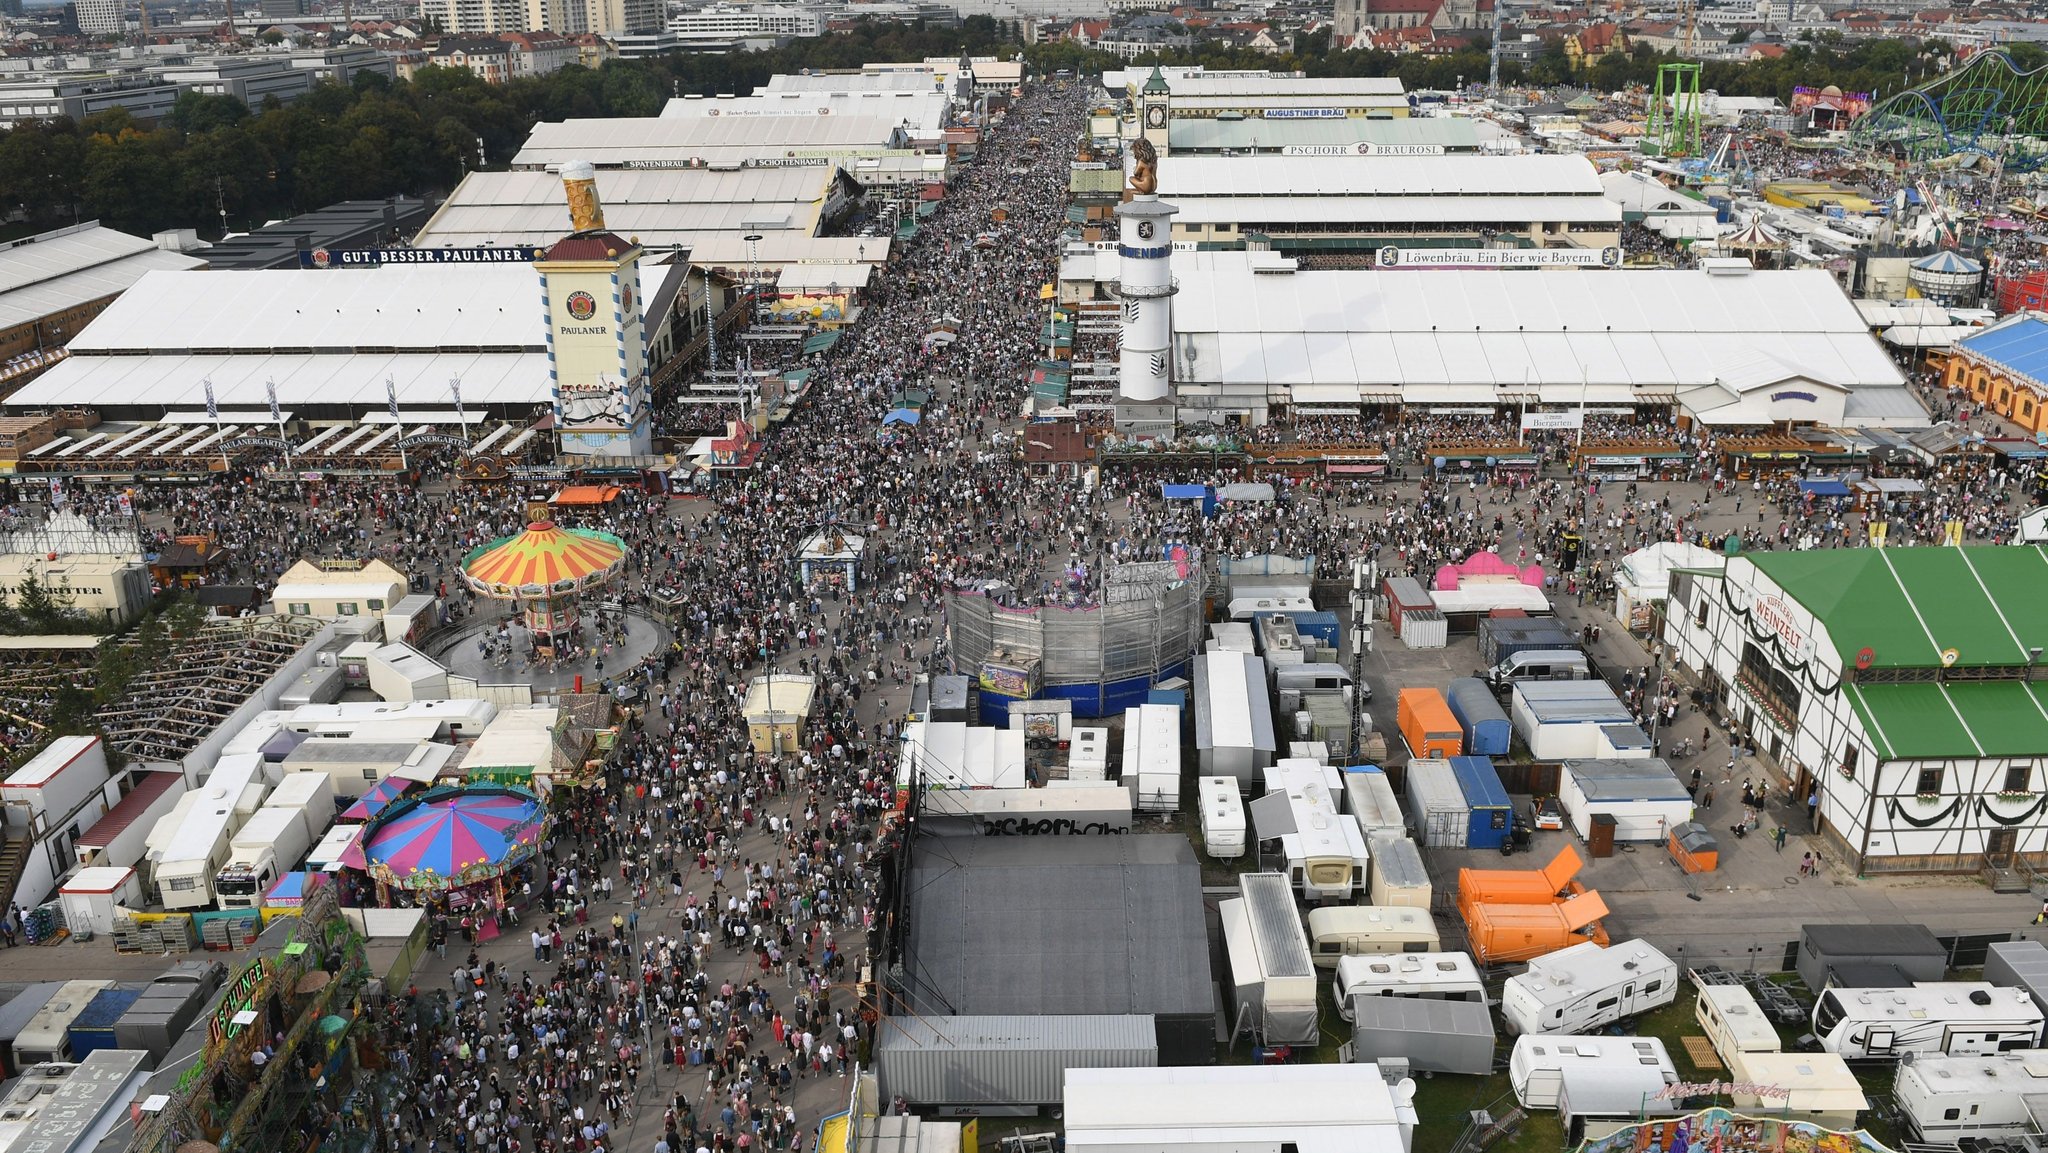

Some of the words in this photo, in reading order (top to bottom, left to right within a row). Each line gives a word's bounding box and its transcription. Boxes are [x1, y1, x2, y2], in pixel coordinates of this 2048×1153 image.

[1266, 109, 1320, 118] AUGUSTINER
[1321, 107, 1344, 117] BRÄU
[1290, 146, 1348, 155] PSCHORR
[1377, 145, 1439, 154] BRÄUROSL
[758, 157, 828, 167] SCHOTTENHAMEL
[342, 251, 377, 264] GUT,
[381, 250, 440, 263] BESSER,
[443, 249, 528, 262] PAULANER.
[1406, 252, 1474, 263] Löwenbräu.
[1477, 252, 1497, 263] Ein
[1501, 252, 1525, 263] Bier
[1528, 252, 1547, 263] wie
[1551, 252, 1595, 265] Bayern.
[561, 326, 607, 335] PAULANER
[1533, 419, 1572, 429] Biergarten
[218, 438, 290, 452] PAULANERGARTEN
[398, 436, 470, 449] PAULANERGARTEN
[1766, 596, 1793, 625] KUFFLERS
[1756, 598, 1802, 649] WEINZELT
[211, 957, 269, 1046] DSCHUNGEL
